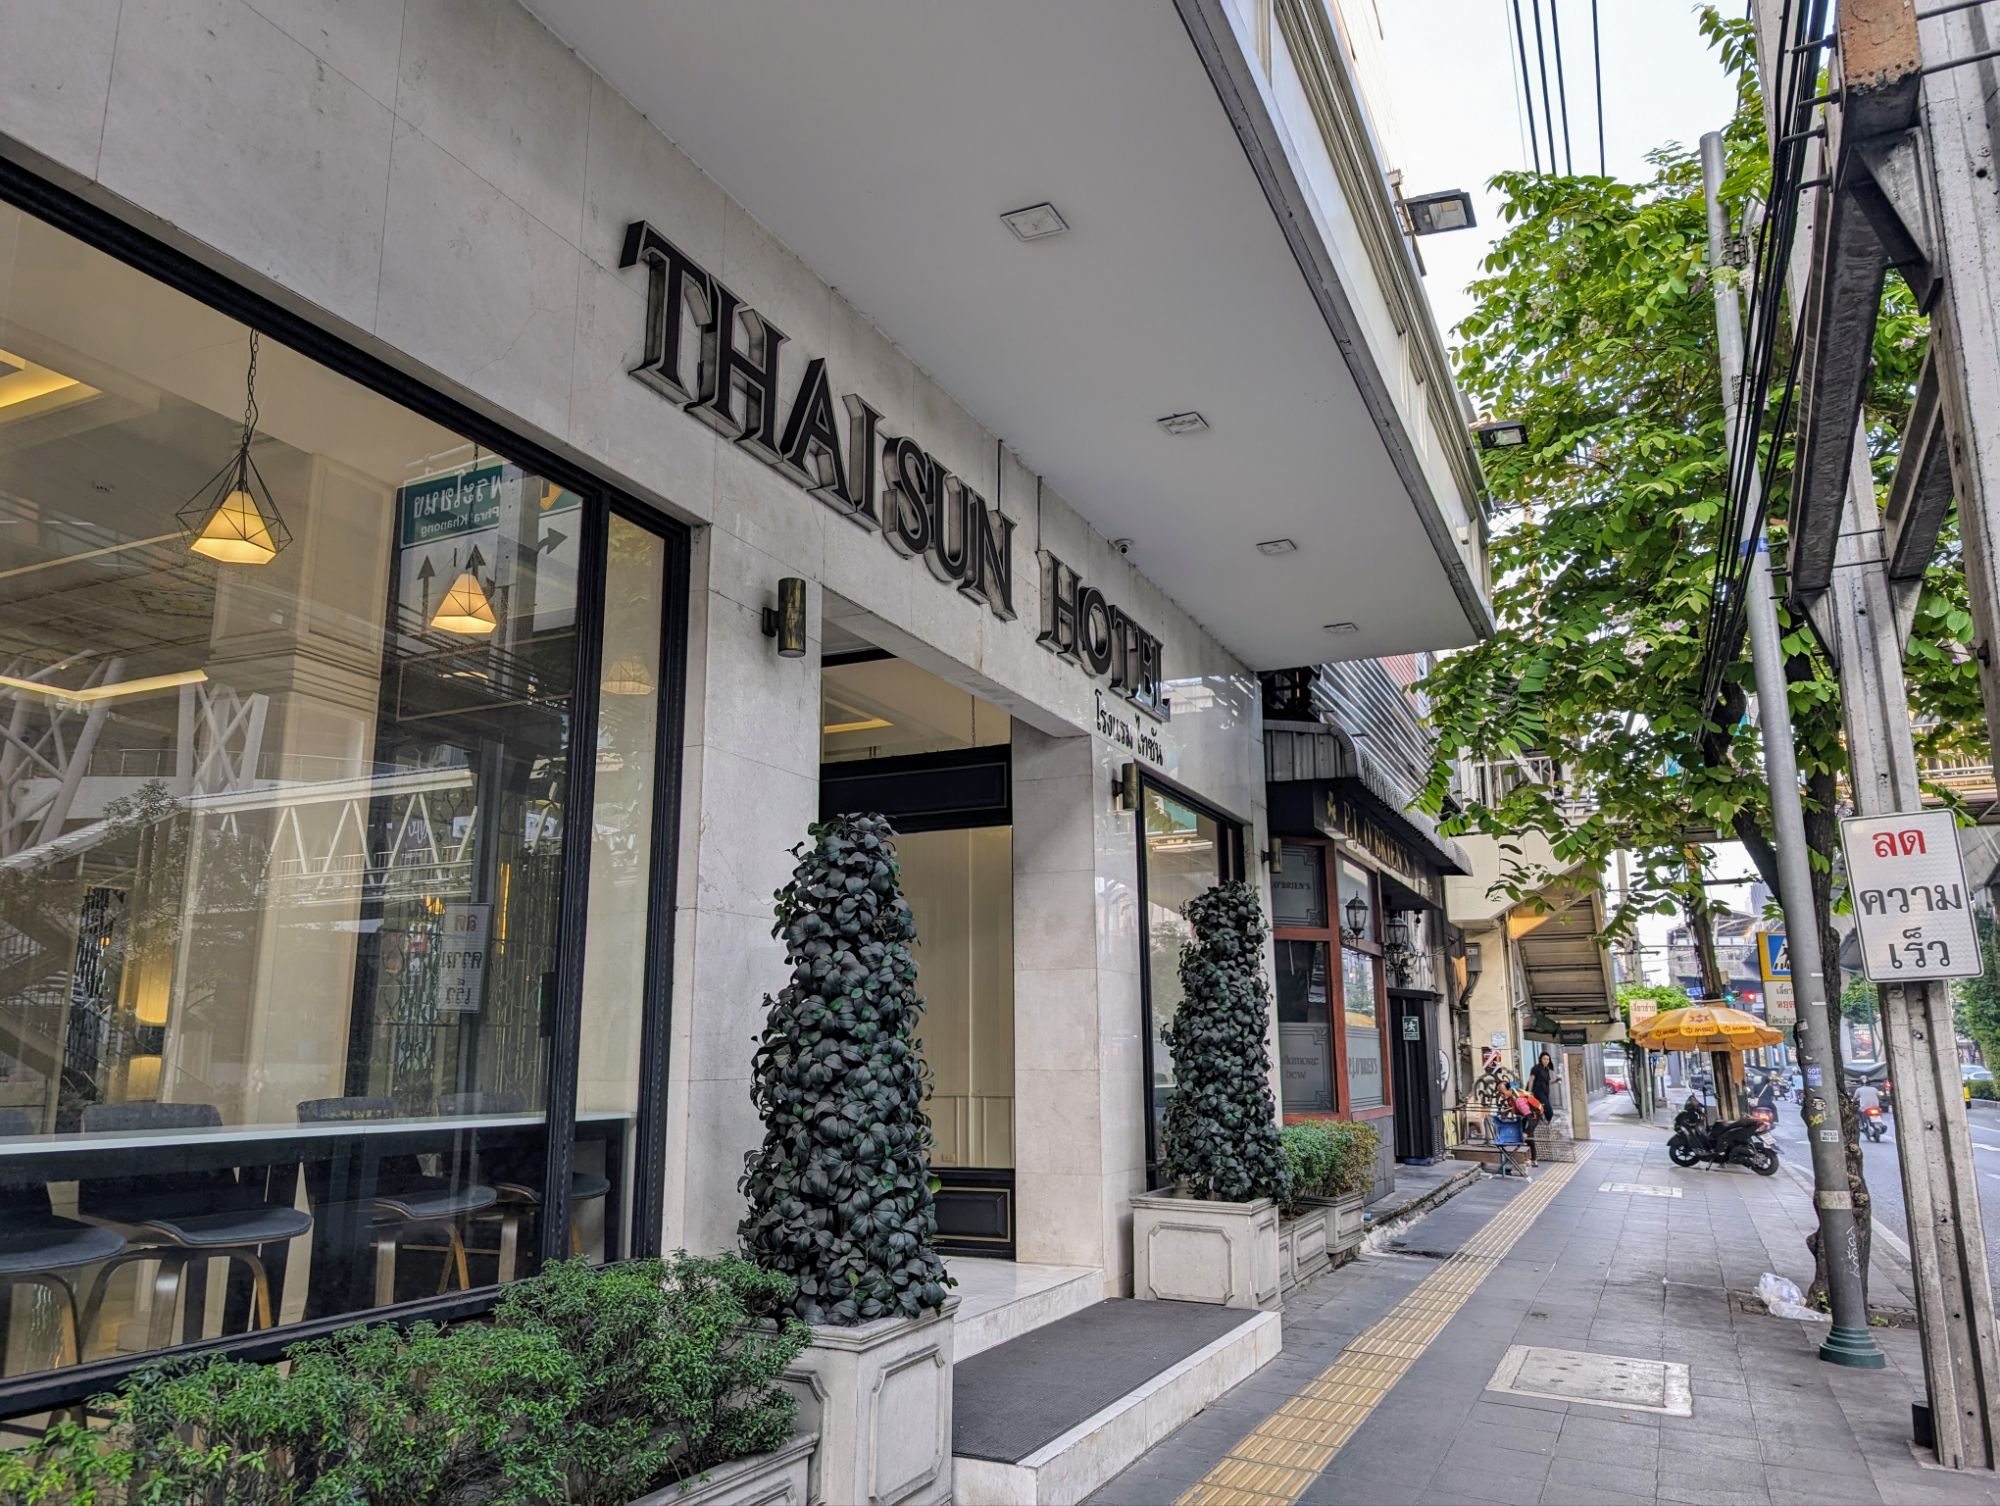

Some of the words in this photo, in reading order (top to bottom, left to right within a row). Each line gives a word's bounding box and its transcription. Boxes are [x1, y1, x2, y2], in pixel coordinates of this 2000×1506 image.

[1035, 549, 1171, 722] HOTEL
[1095, 688, 1133, 750] โรงแรม
[1871, 828, 1928, 858] ลด
[1859, 883, 1963, 916] ความ
[1888, 926, 1951, 970] เร็ว
